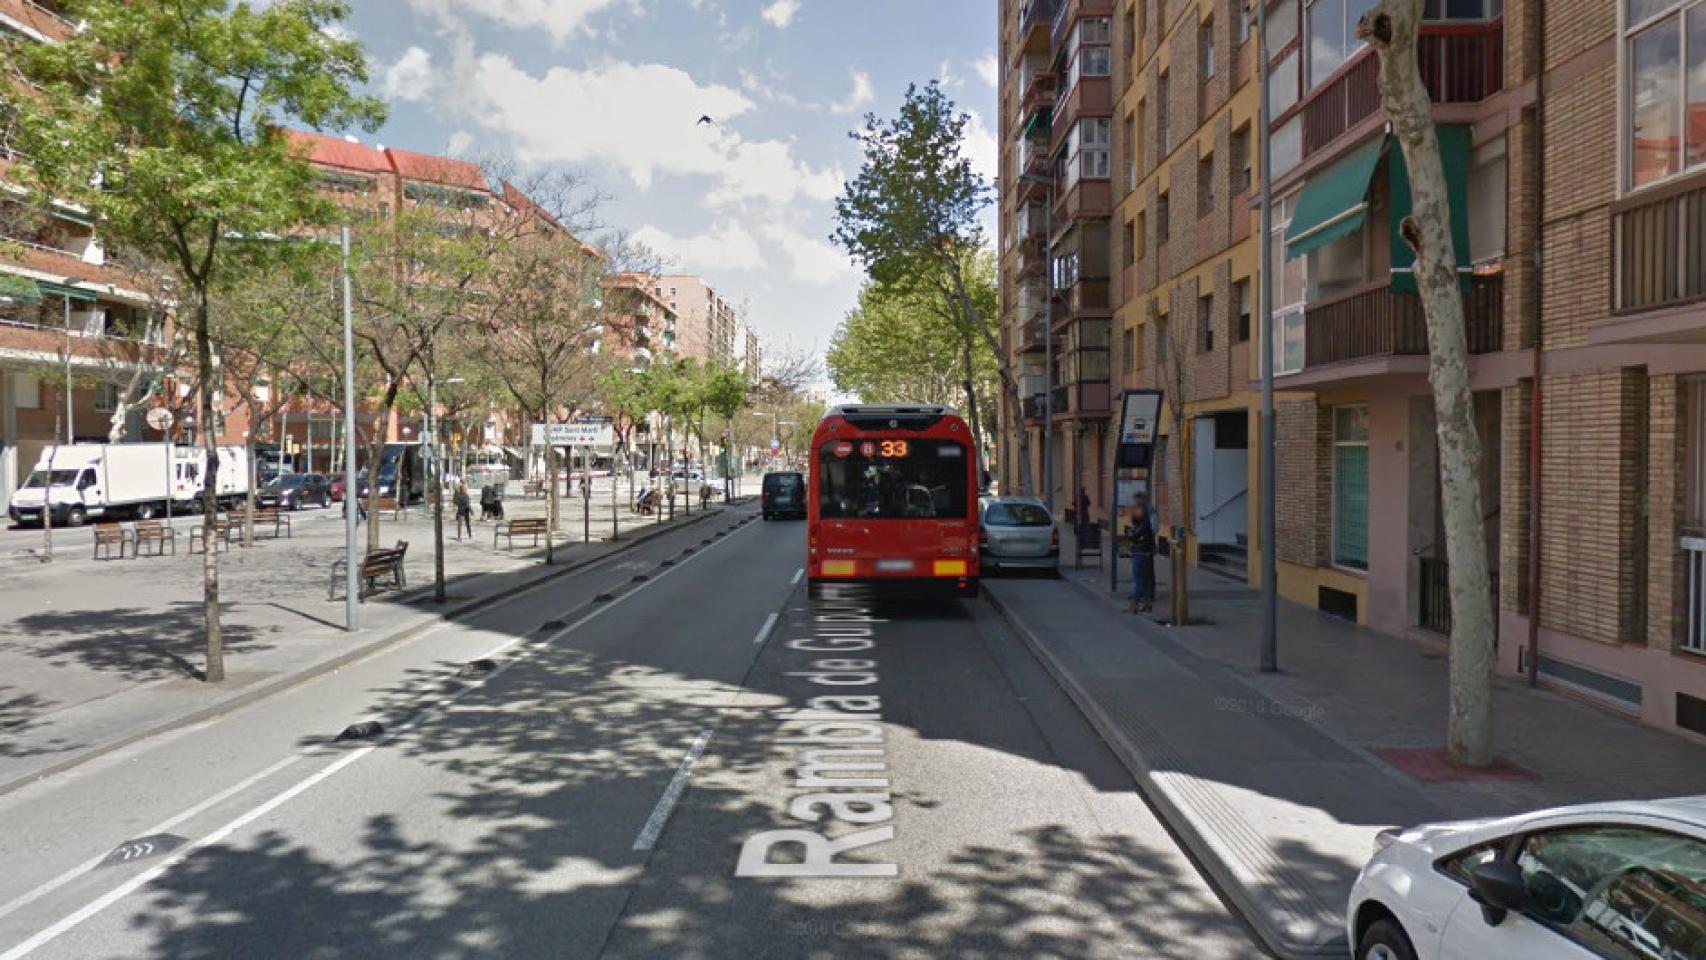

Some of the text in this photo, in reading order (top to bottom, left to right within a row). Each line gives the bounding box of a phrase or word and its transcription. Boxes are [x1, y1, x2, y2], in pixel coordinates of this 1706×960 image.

[881, 440, 908, 457] 33
[783, 658, 880, 686] de
[735, 695, 899, 877] Rambla
